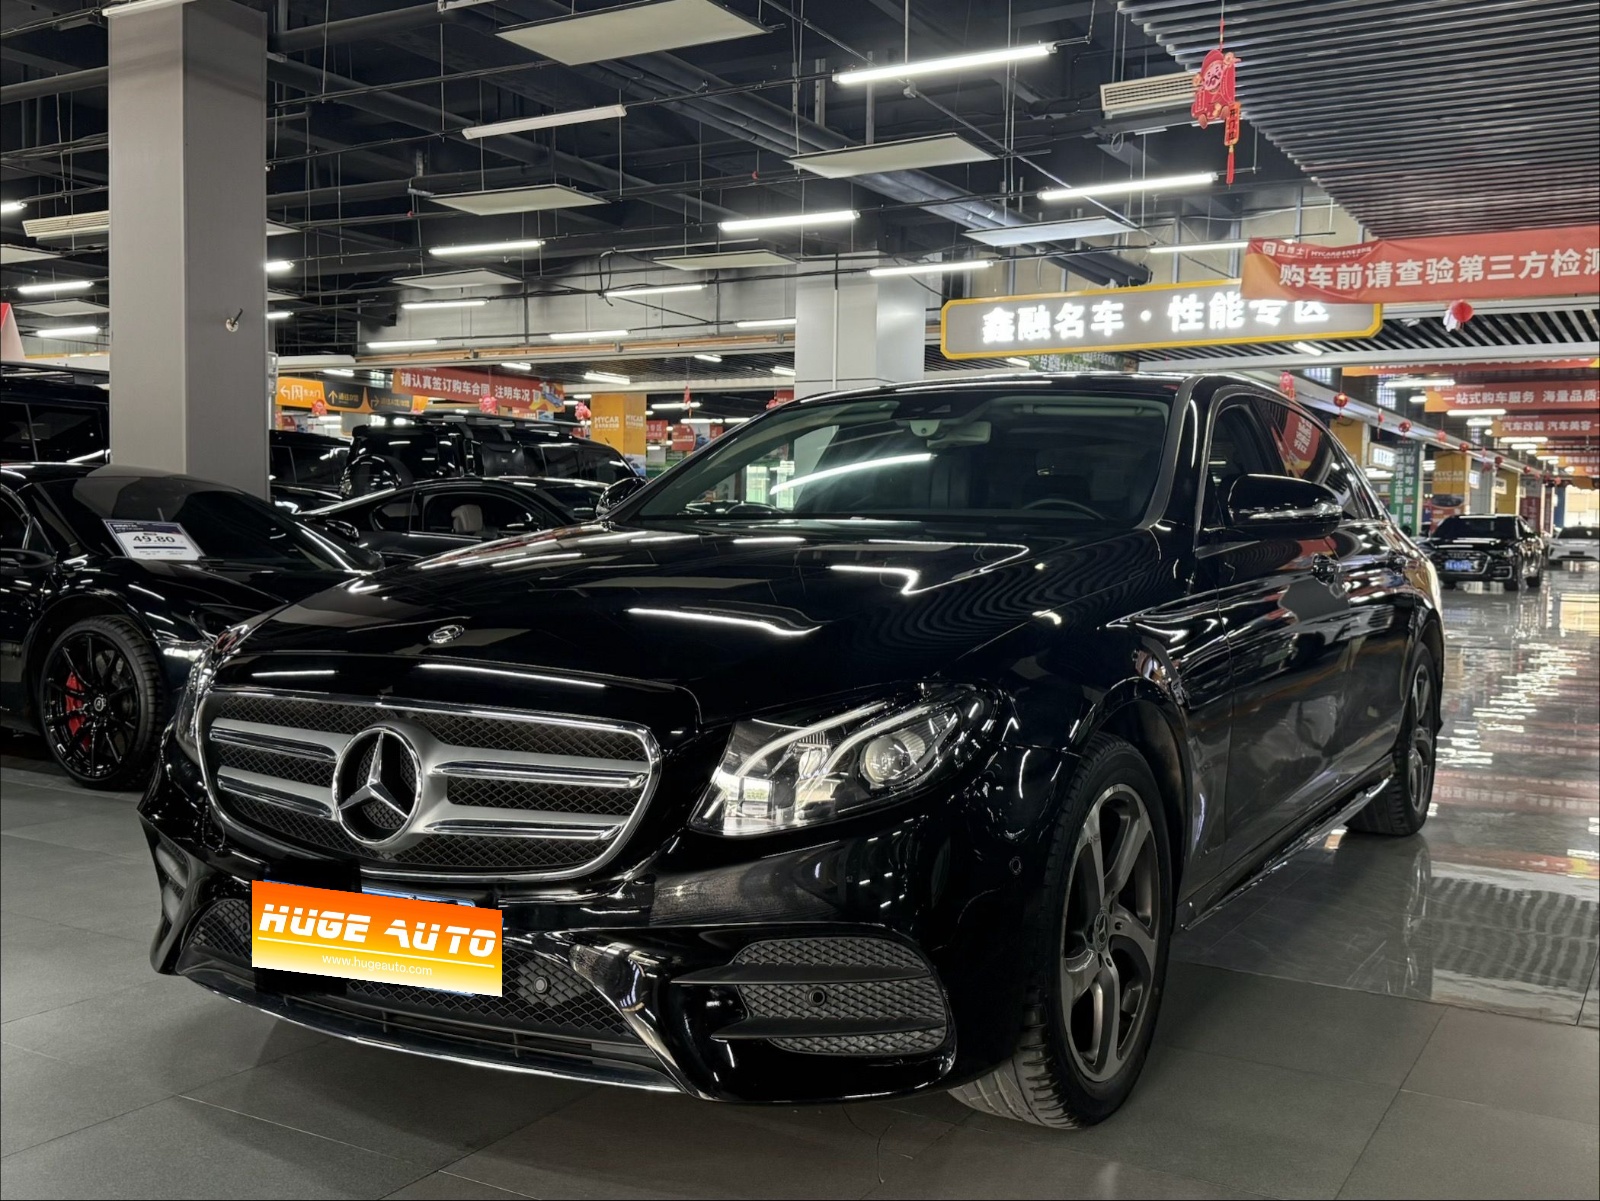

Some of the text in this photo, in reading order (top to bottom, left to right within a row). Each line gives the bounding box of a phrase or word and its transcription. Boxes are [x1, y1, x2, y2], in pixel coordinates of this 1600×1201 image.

[400, 372, 490, 396] 请认真签订购车合同
[1442, 388, 1599, 405] 一站式购车服务 海量品质
[594, 416, 620, 424] MYCAR
[1502, 420, 1592, 432] 汽车改装 汽车美容
[133, 535, 176, 543] 49.80
